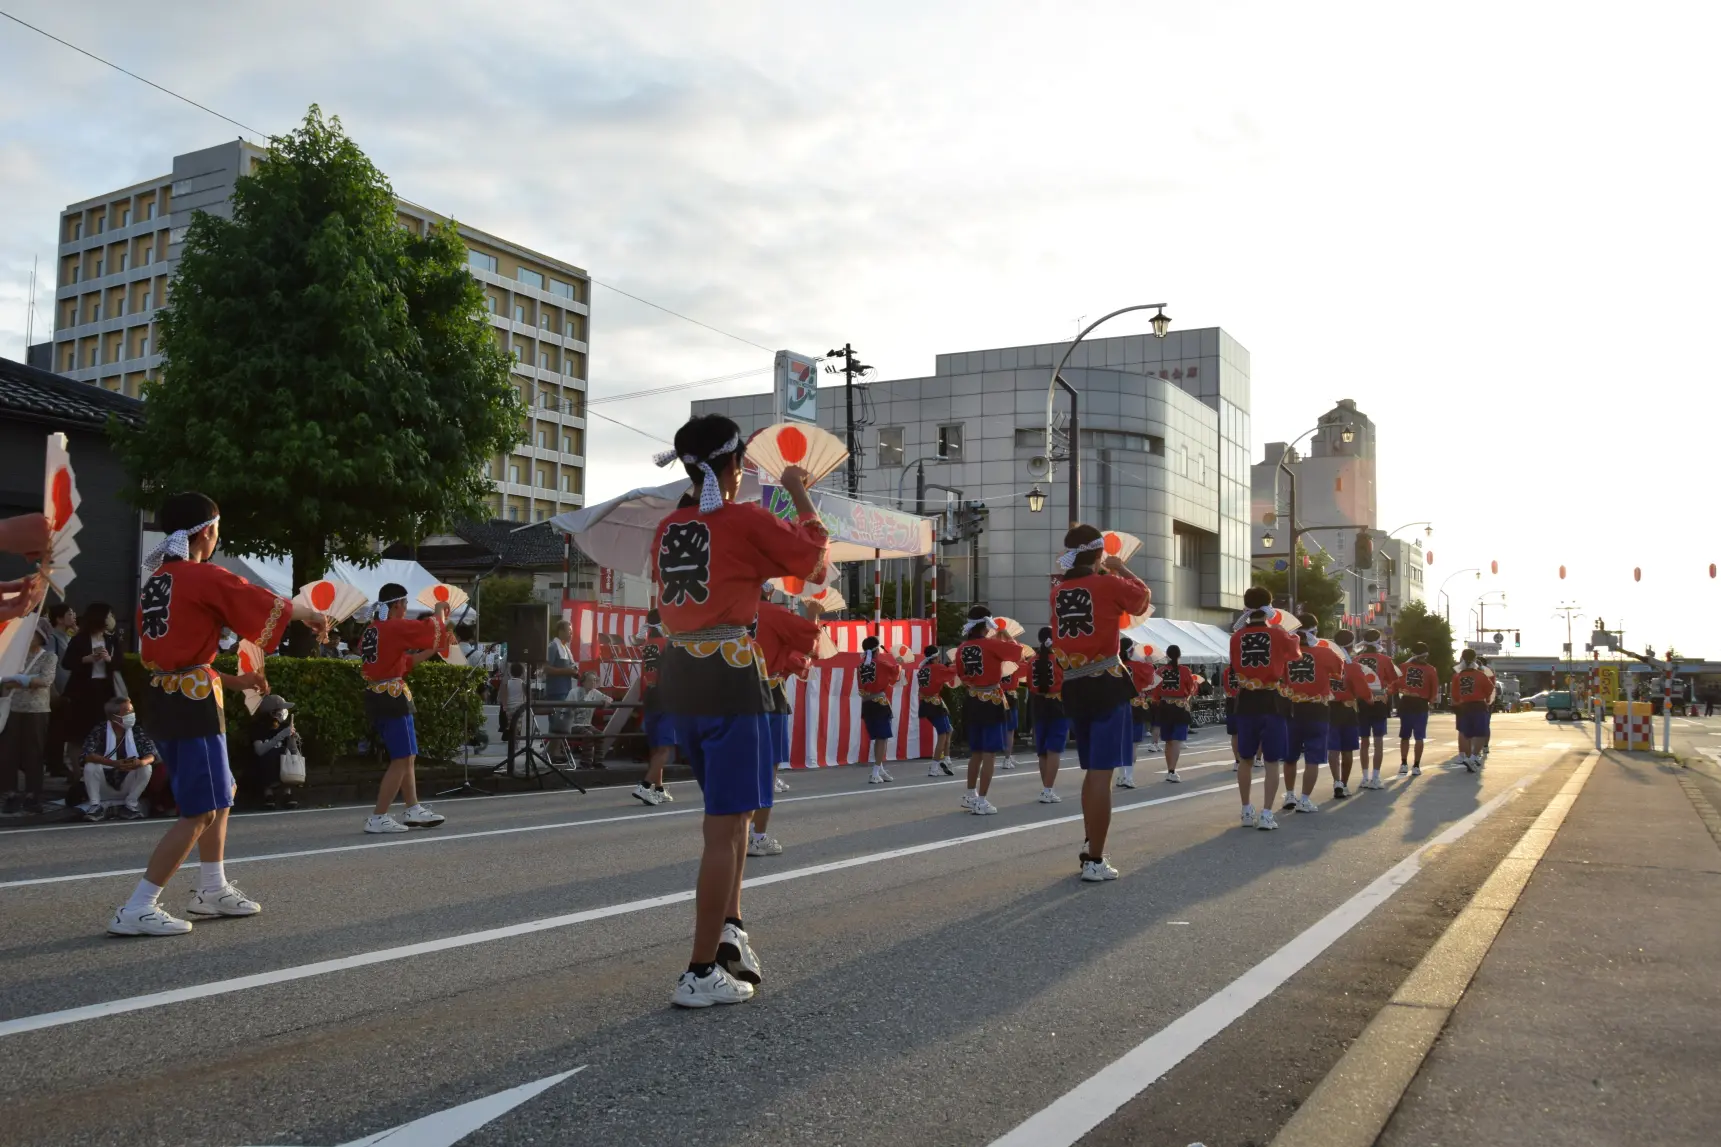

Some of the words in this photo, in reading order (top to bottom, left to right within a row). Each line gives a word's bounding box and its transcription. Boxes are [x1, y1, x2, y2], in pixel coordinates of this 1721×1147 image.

[658, 520, 711, 606] 祭
[1055, 587, 1095, 638] 祭
[962, 645, 984, 677] 祭
[1241, 632, 1271, 668] 祭
[917, 667, 931, 688] 祭
[1161, 668, 1180, 691] 祭
[1406, 667, 1423, 688] 祭
